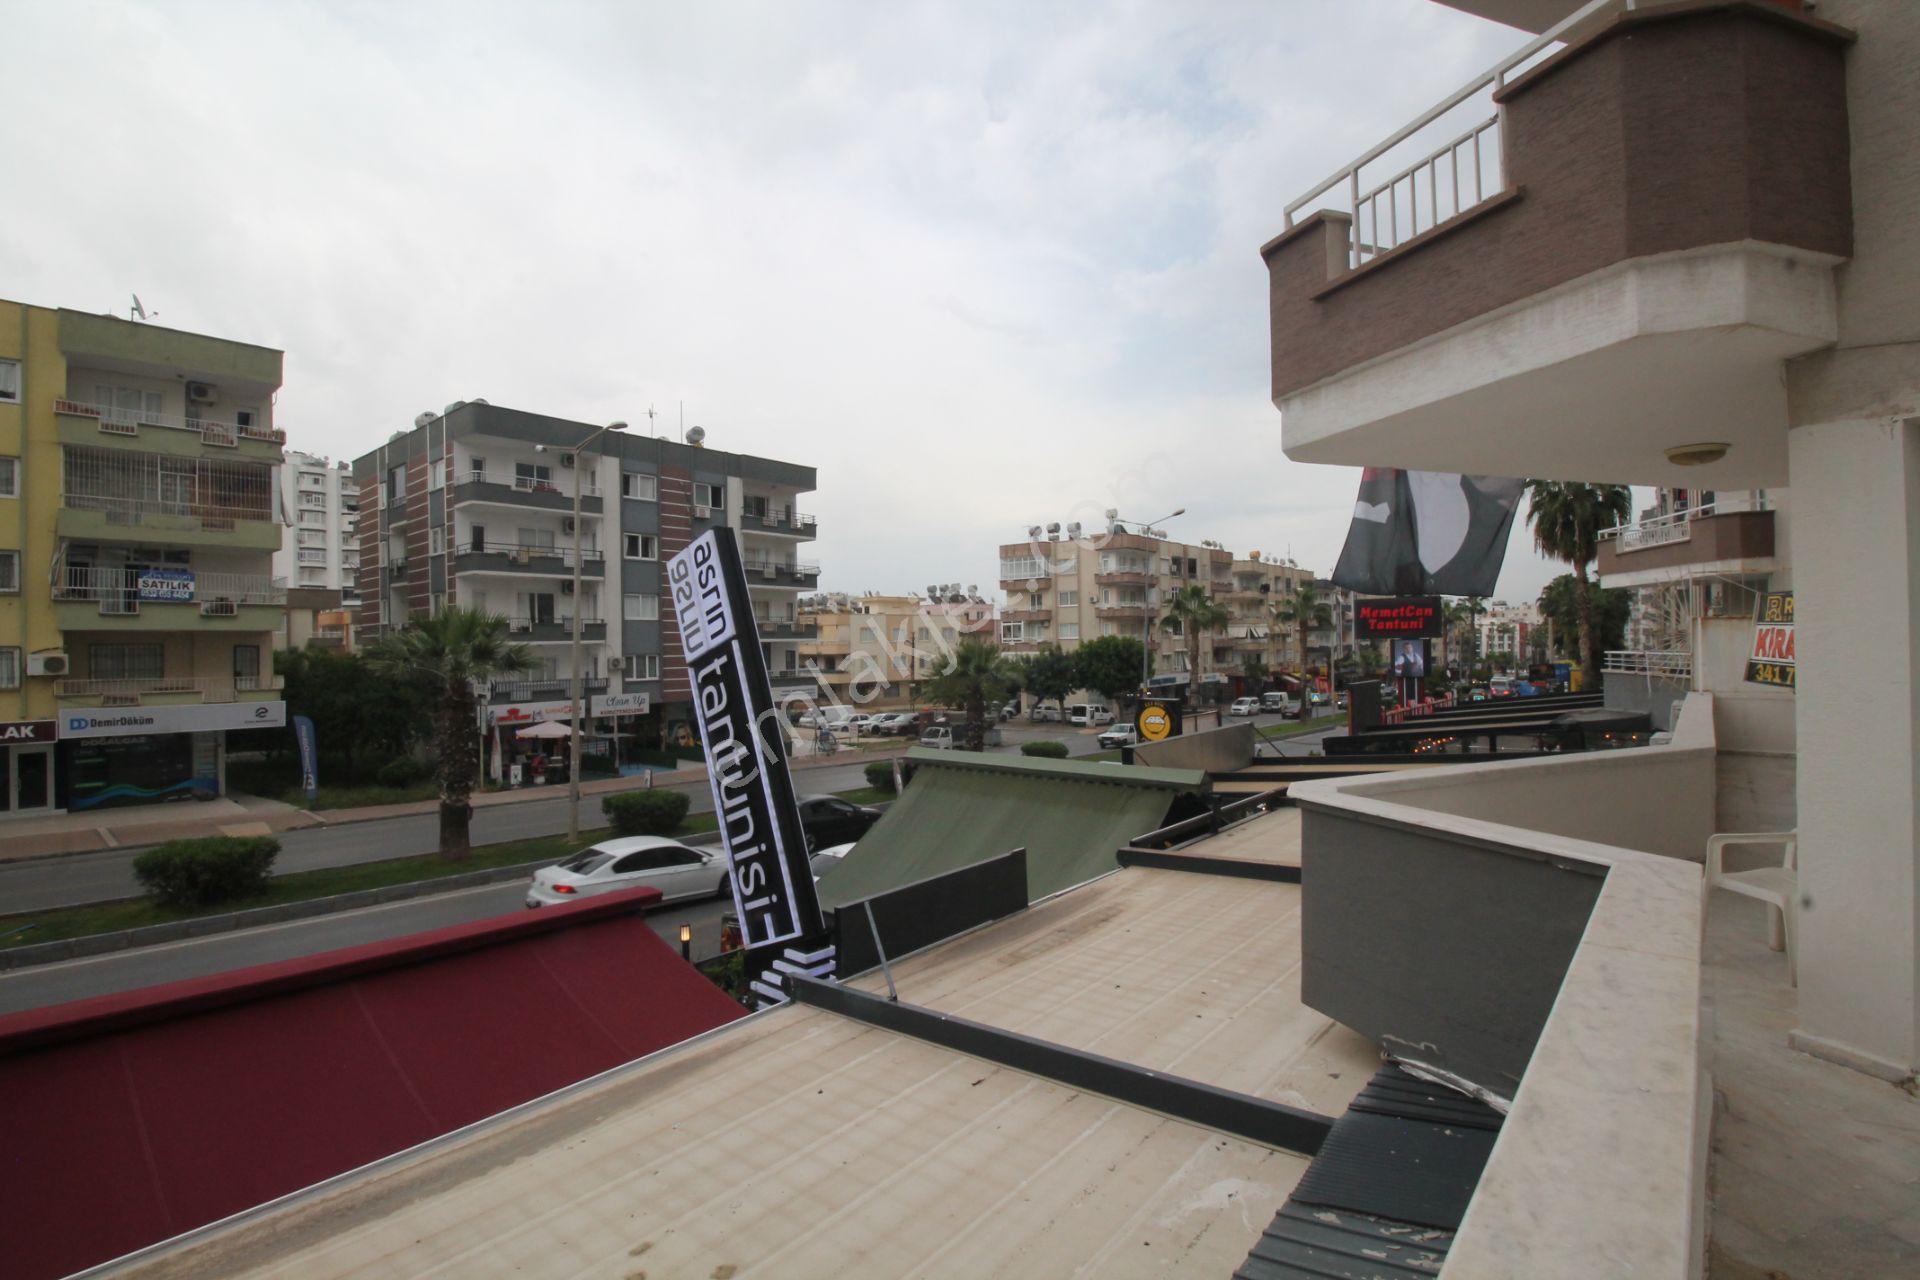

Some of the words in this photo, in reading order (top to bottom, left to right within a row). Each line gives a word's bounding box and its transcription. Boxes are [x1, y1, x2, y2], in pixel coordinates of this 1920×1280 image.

[142, 579, 191, 590] SATILIK
[1360, 605, 1433, 618] MemetCan
[1368, 617, 1424, 630] Tantuni
[90, 716, 154, 729] DemirDöküm
